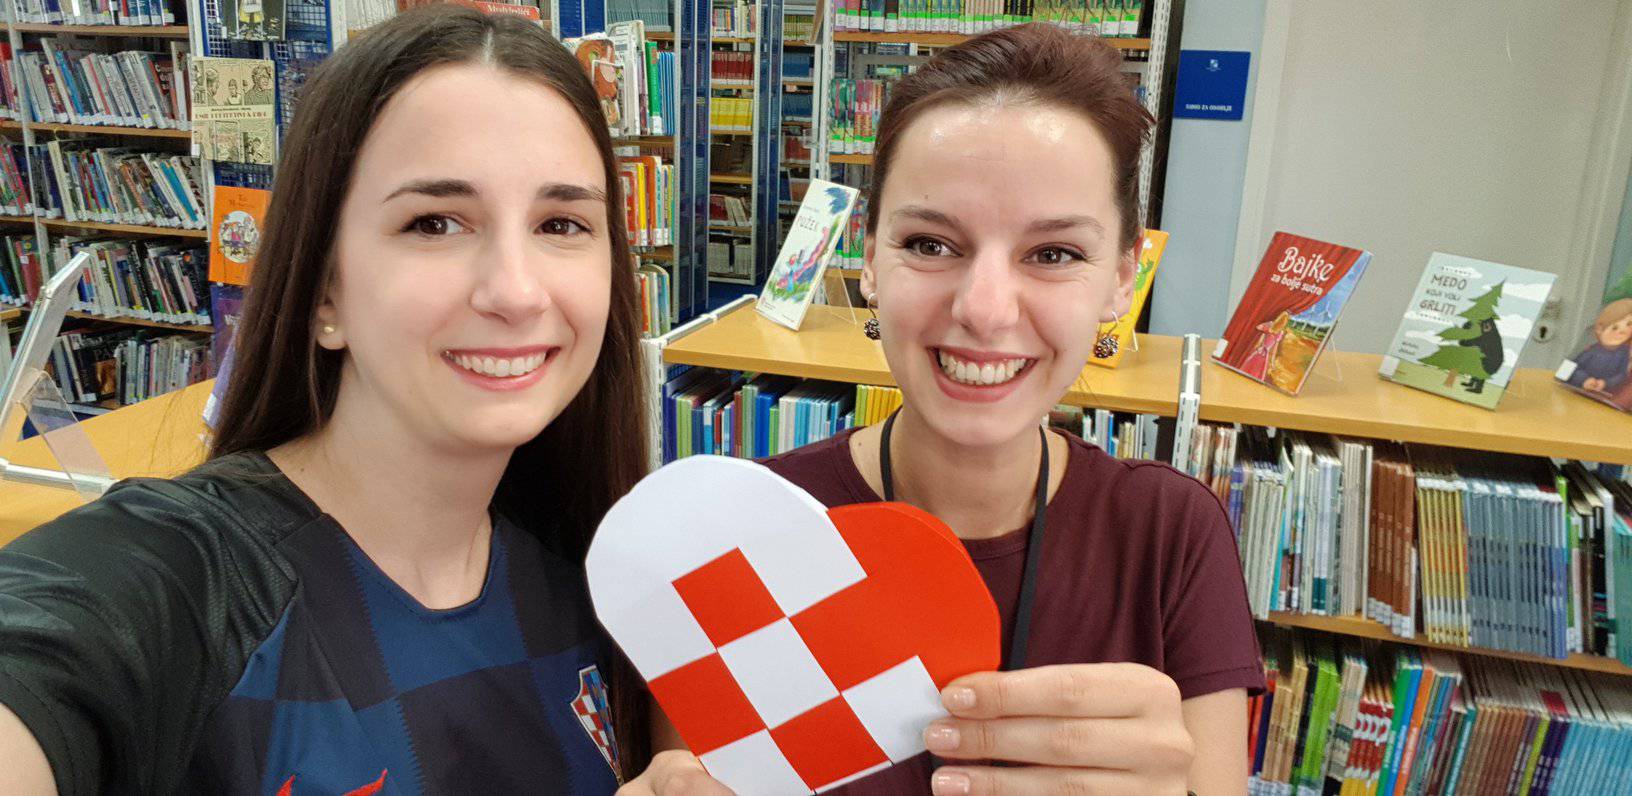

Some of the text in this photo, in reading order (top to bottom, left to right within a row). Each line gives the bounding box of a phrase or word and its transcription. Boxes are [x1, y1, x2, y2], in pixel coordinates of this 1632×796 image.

[1278, 246, 1334, 281] Bajke
[1270, 273, 1323, 296] za bolje sutra
[1431, 273, 1468, 290] MEDO
[1419, 300, 1457, 316] GRLITI
